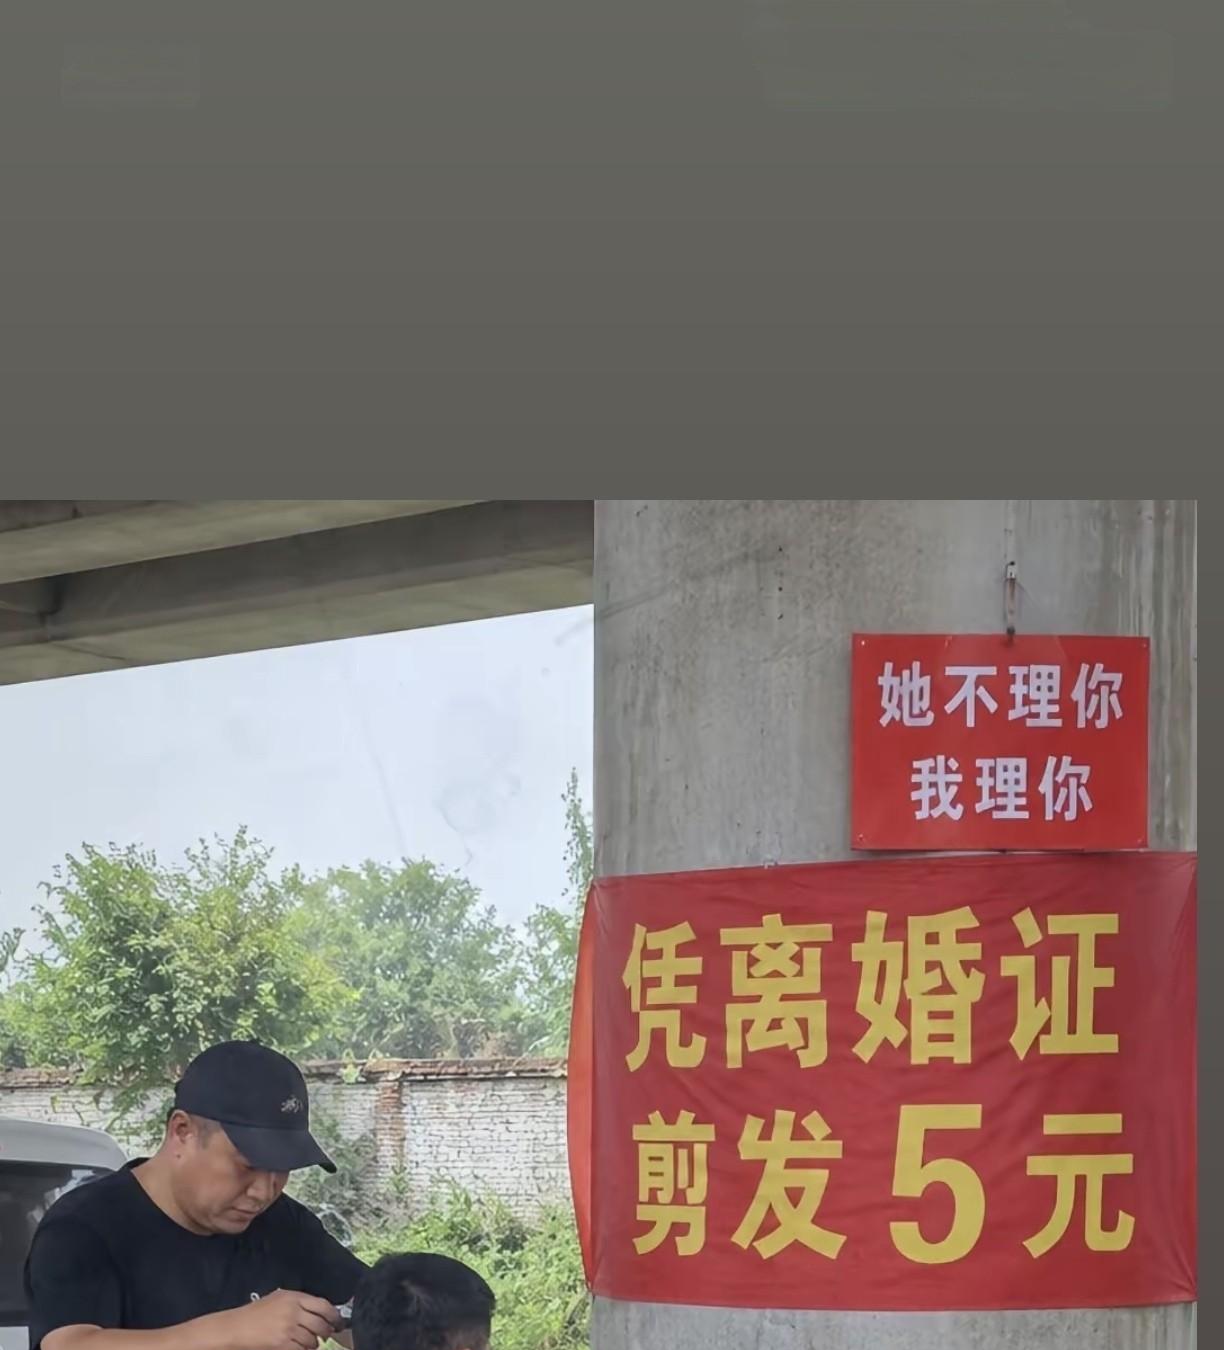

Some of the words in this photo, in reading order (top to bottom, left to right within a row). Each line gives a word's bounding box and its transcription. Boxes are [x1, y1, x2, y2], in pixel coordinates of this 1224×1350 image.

[877, 661, 1123, 729] 她不理你
[910, 755, 1093, 821] 我理你
[622, 906, 1119, 1072] 凭离婚证
